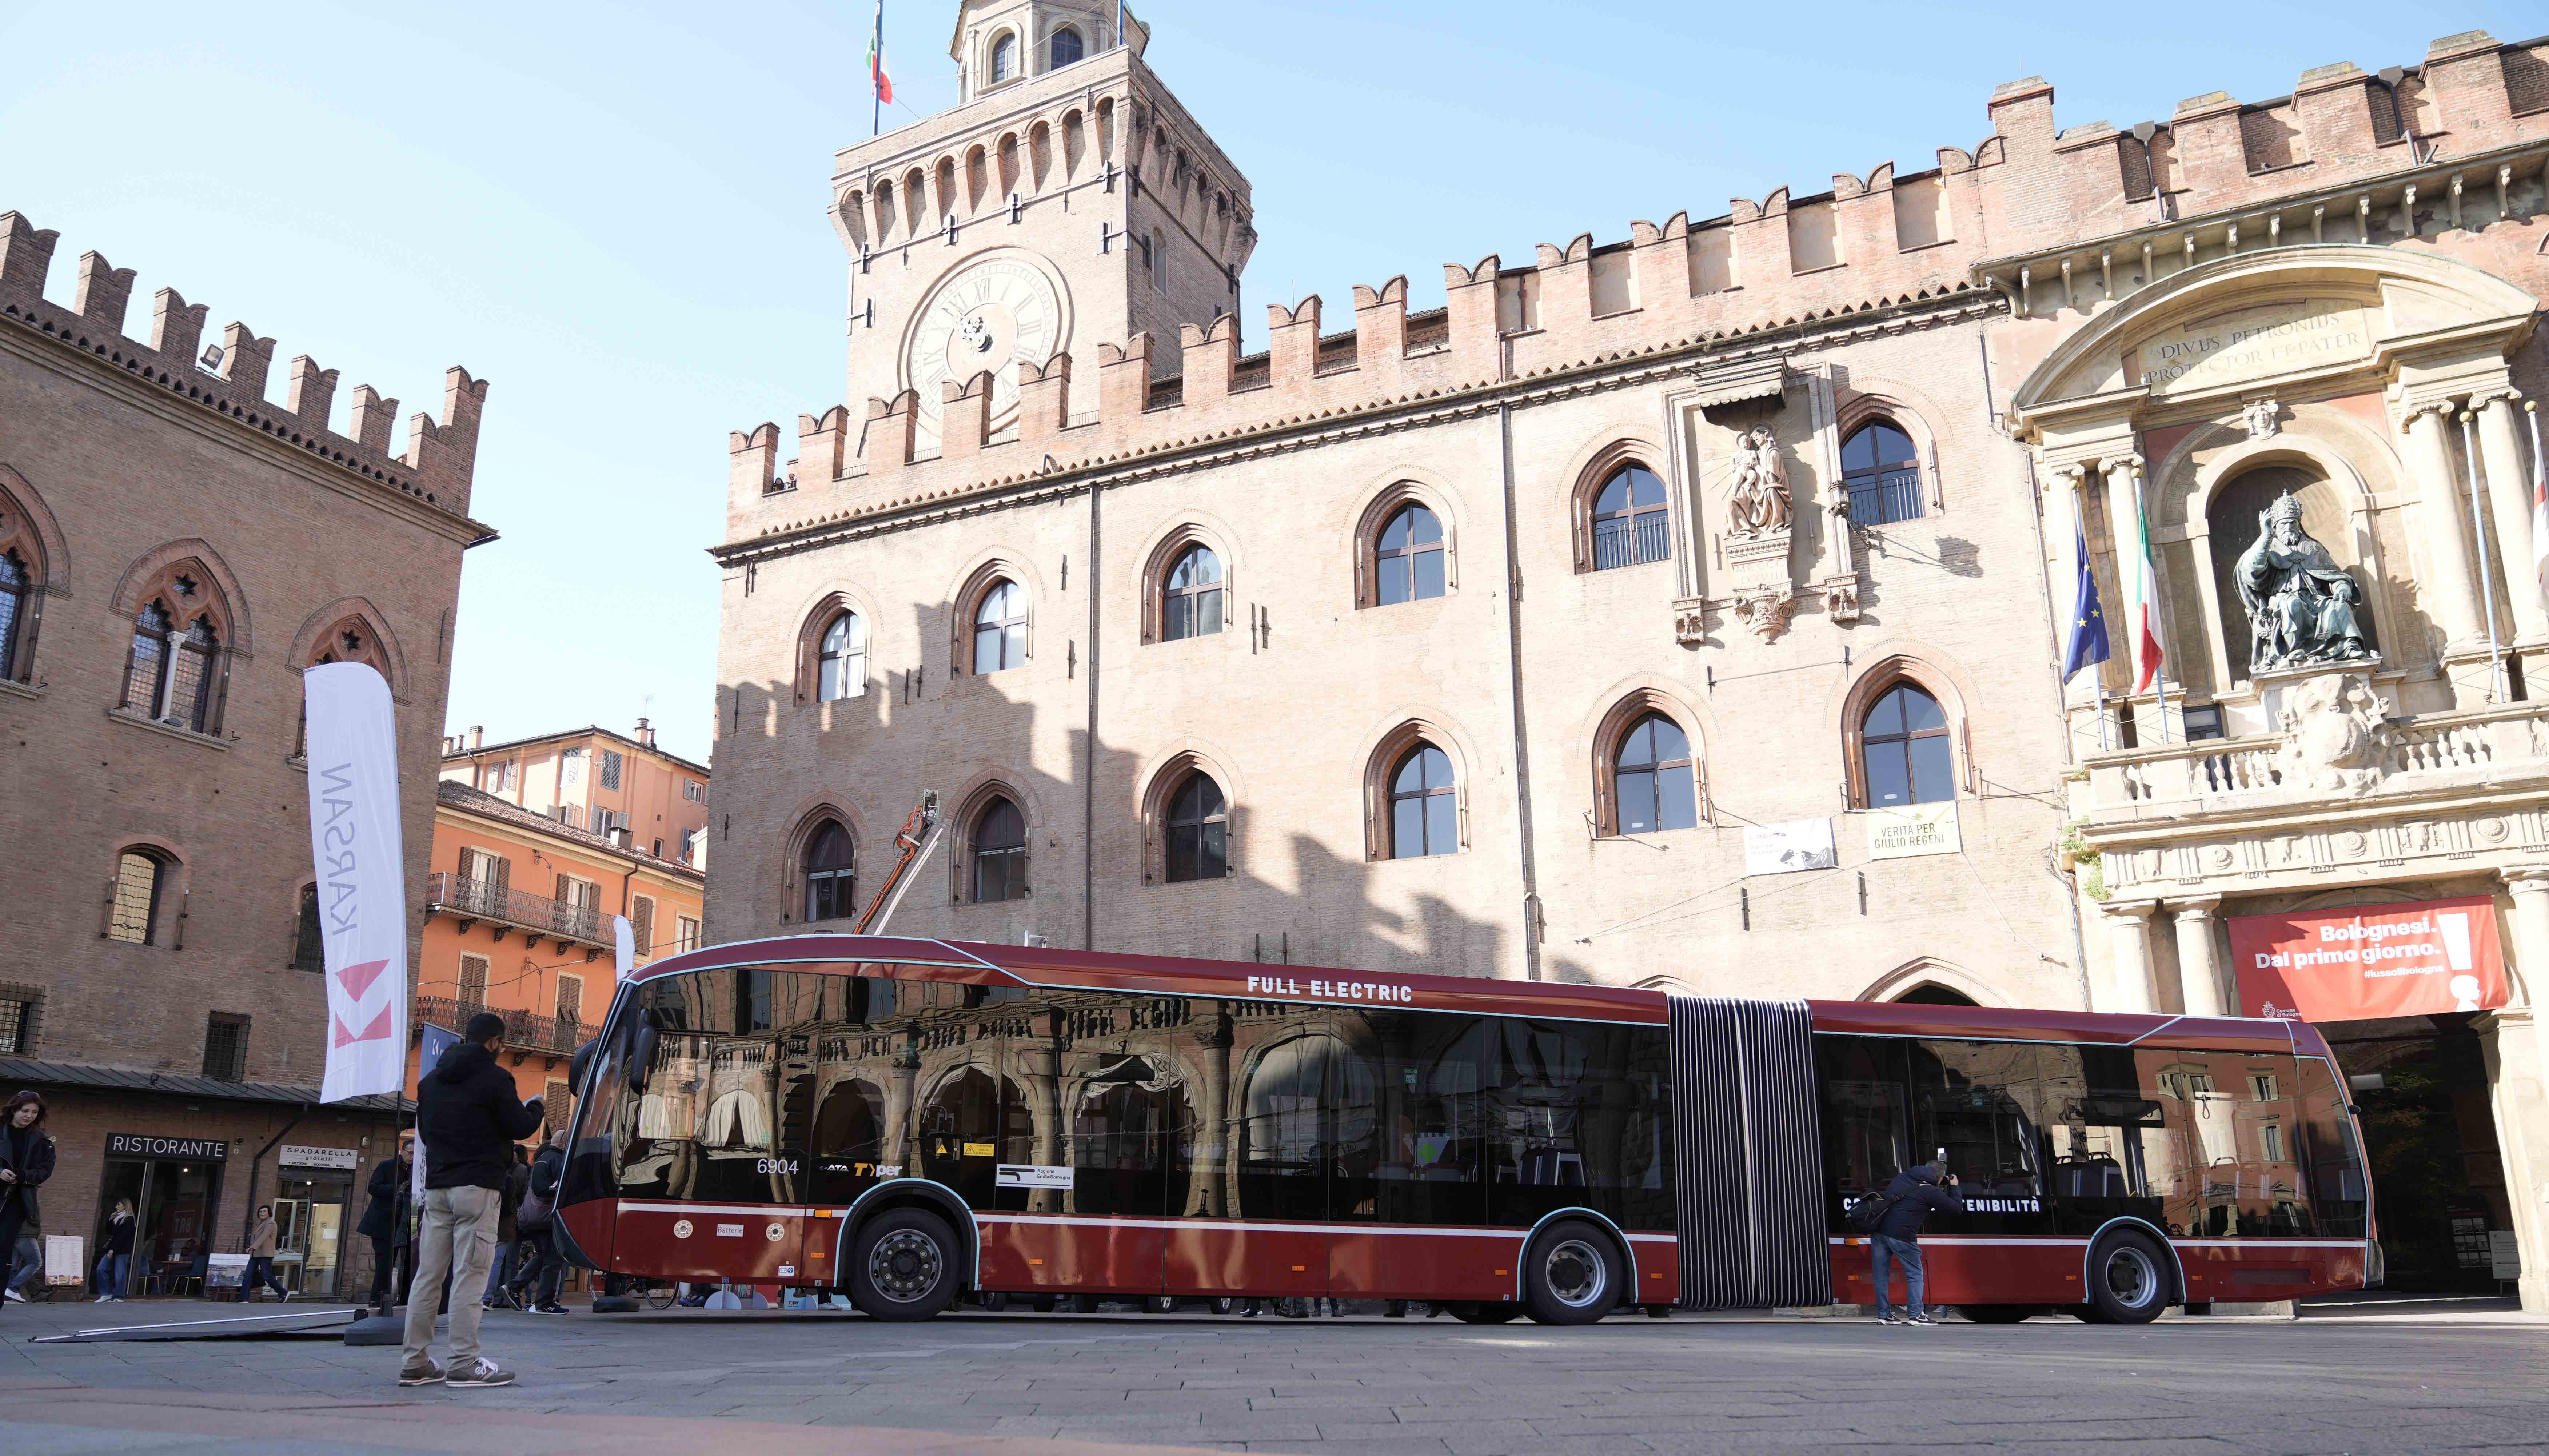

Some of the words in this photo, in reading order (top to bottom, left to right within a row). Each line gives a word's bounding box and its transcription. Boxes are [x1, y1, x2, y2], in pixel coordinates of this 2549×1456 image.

[2232, 313, 2340, 345] PETRONIUS
[2148, 350, 2264, 383] PROTECTOR
[1880, 823, 1914, 837] VERITÀ
[1917, 823, 1935, 834] PER
[1875, 837, 1906, 849] GIULIO
[1909, 834, 1944, 847] REGENI
[2320, 916, 2437, 942] Bolognesi.
[2255, 950, 2290, 969] Dal
[2293, 948, 2358, 970] primo
[2361, 943, 2441, 965] giorno.
[2363, 965, 2444, 978] #iussolibologna
[1248, 976, 1300, 995] FULL
[1311, 980, 1412, 1002] ELECTRIC
[113, 1136, 224, 1157] RISTORANTE
[287, 1148, 351, 1157] SPADARELLA
[757, 1158, 799, 1175] 6904
[718, 1226, 743, 1234] Batterie
